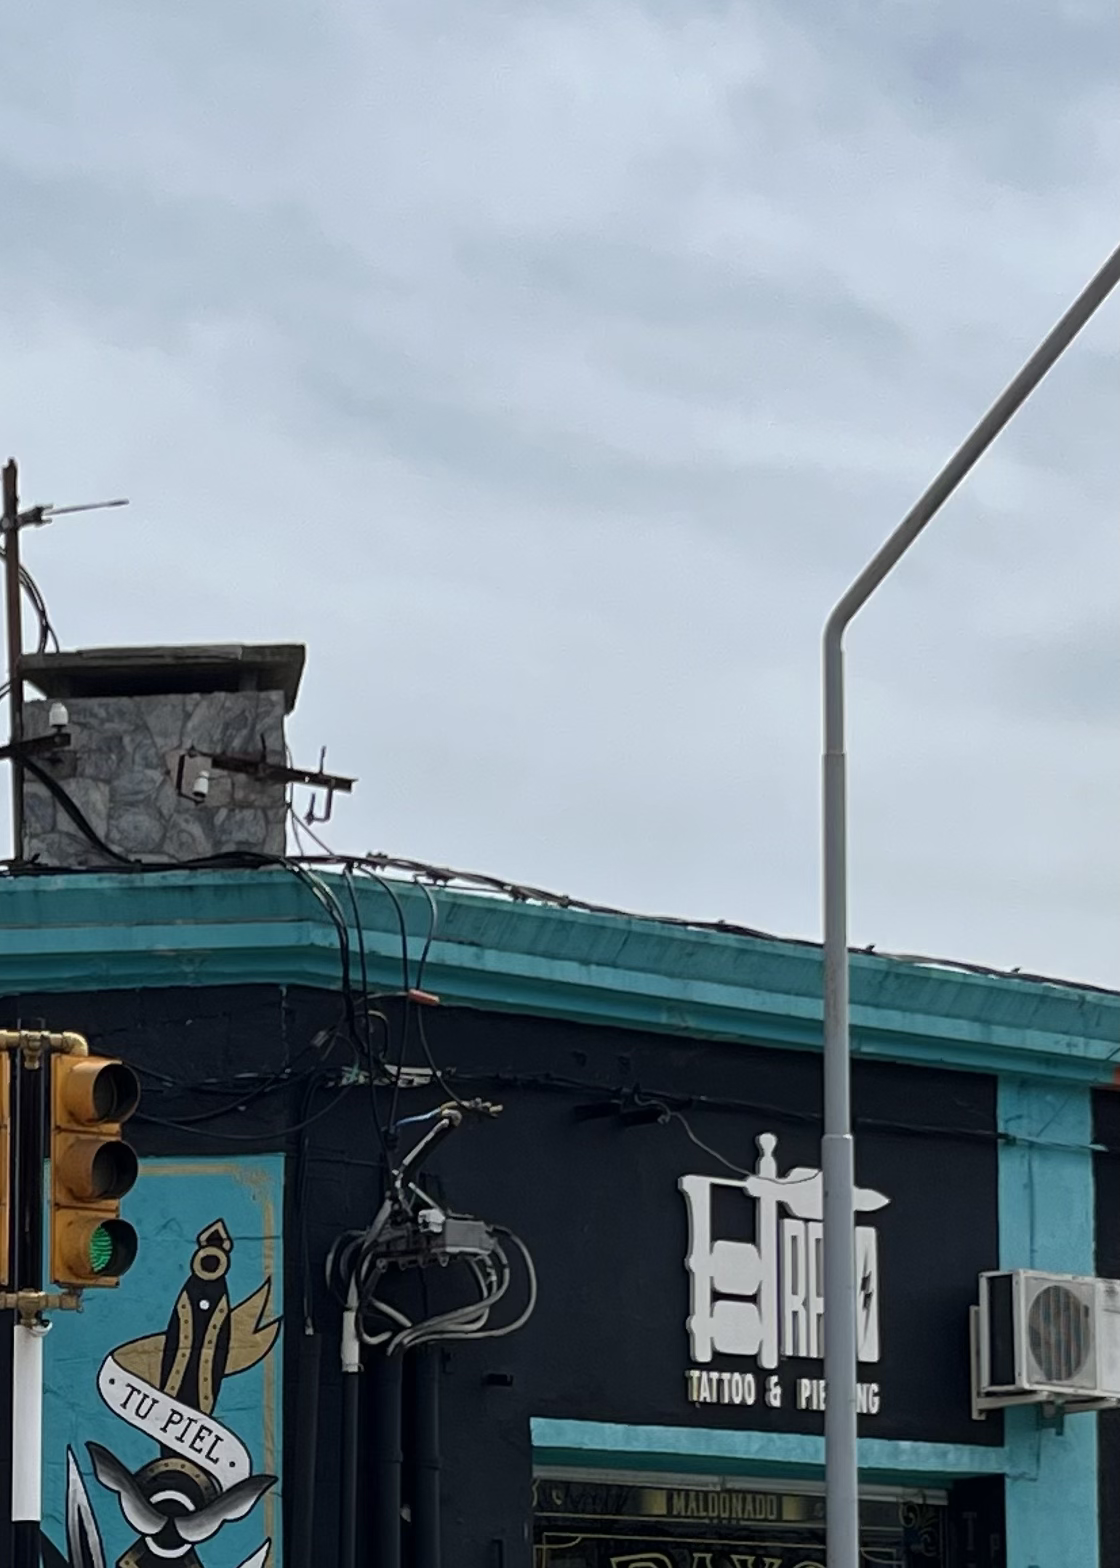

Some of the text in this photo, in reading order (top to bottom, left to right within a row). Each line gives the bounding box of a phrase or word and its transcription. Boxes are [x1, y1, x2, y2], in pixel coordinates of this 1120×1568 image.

[686, 1370, 880, 1414] TATTOO & PIENG
[119, 1383, 224, 1464] TU PIEL
[672, 1491, 778, 1520] MALDONADO
